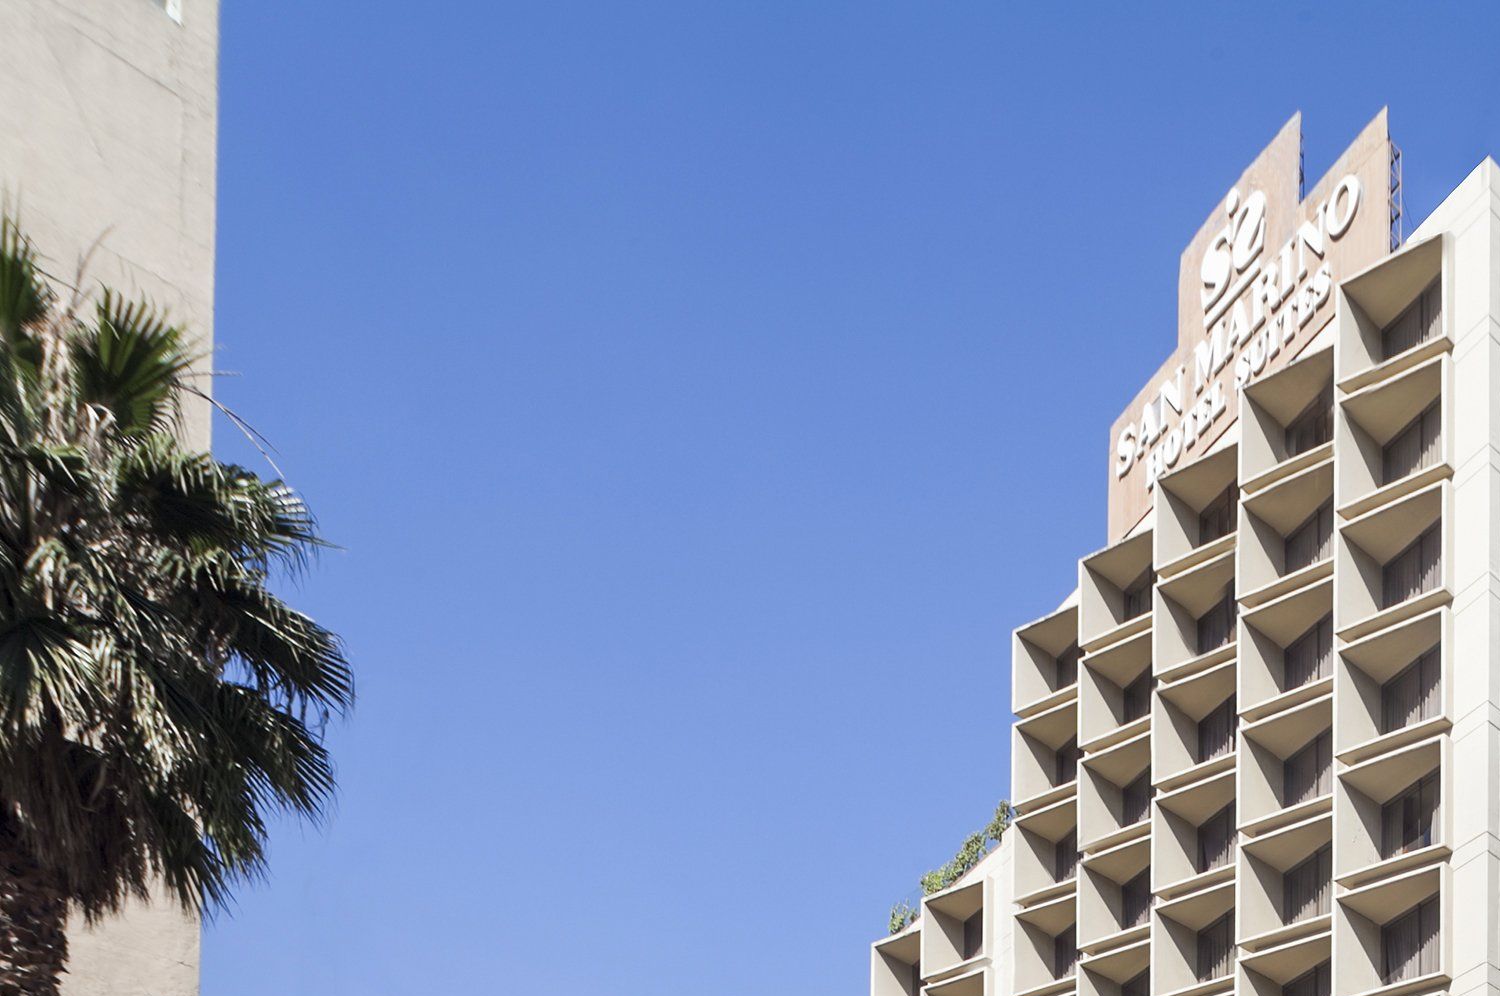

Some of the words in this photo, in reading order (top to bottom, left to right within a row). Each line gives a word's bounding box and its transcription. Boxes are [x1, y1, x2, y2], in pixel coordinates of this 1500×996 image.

[1116, 364, 1185, 480] SAN
[1194, 174, 1362, 396] MARINO
[1146, 379, 1227, 492] HOTEL
[1234, 261, 1332, 393] SUITES
